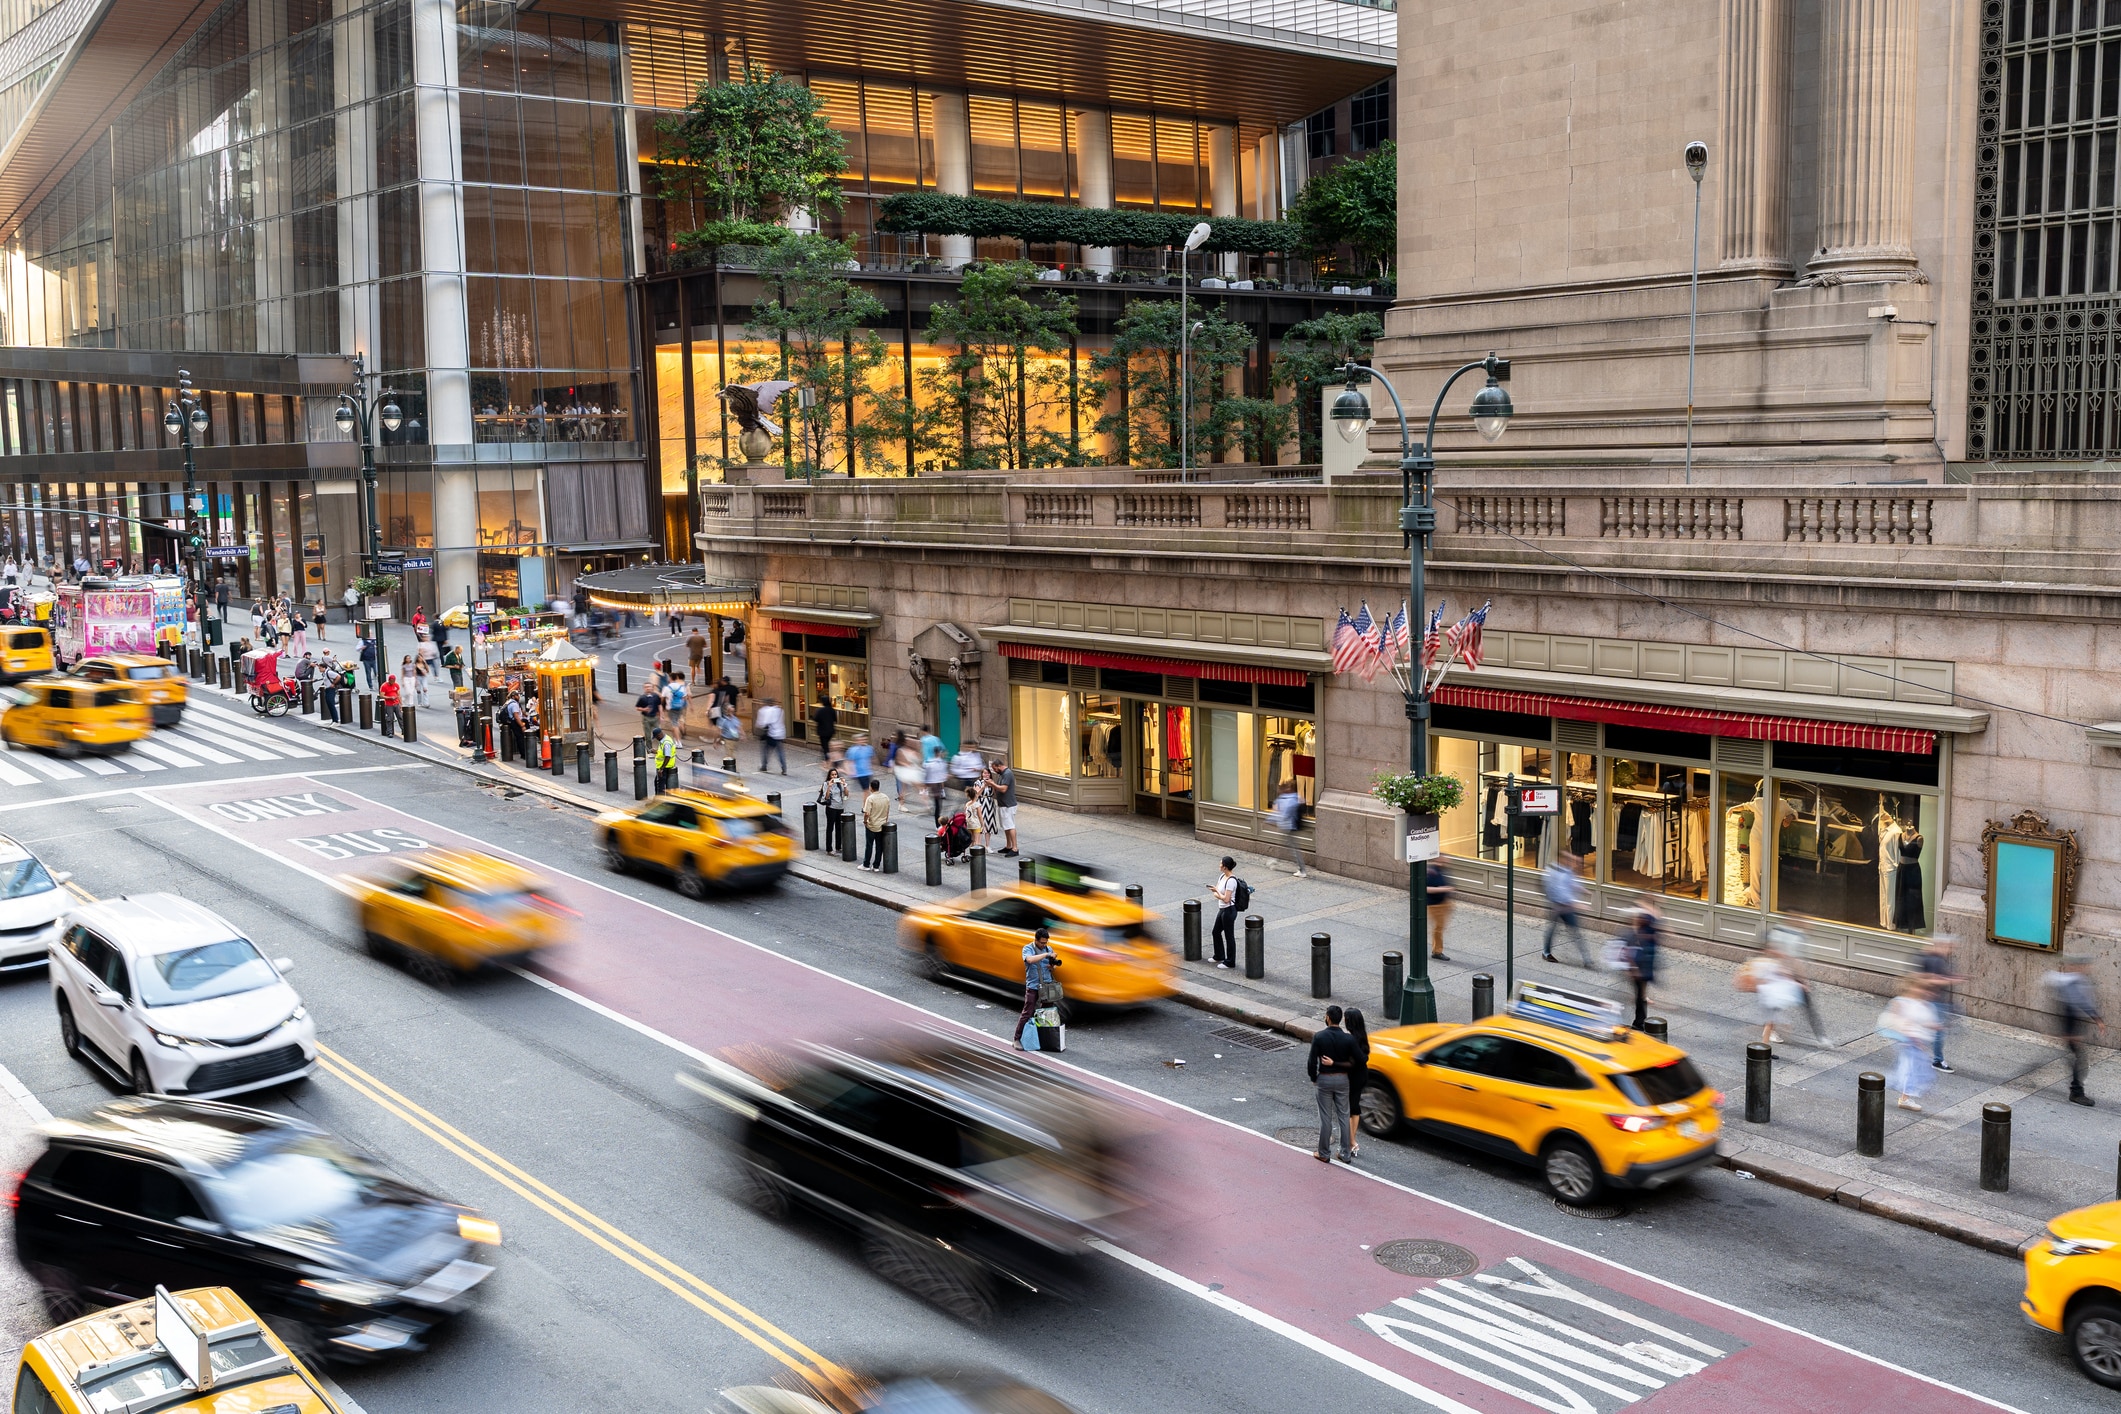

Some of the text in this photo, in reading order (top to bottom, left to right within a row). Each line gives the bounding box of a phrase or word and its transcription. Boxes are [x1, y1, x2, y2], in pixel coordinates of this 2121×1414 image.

[208, 793, 342, 823] ONLY
[286, 828, 429, 860] BUS
[1356, 1255, 1728, 1414] ONLY
